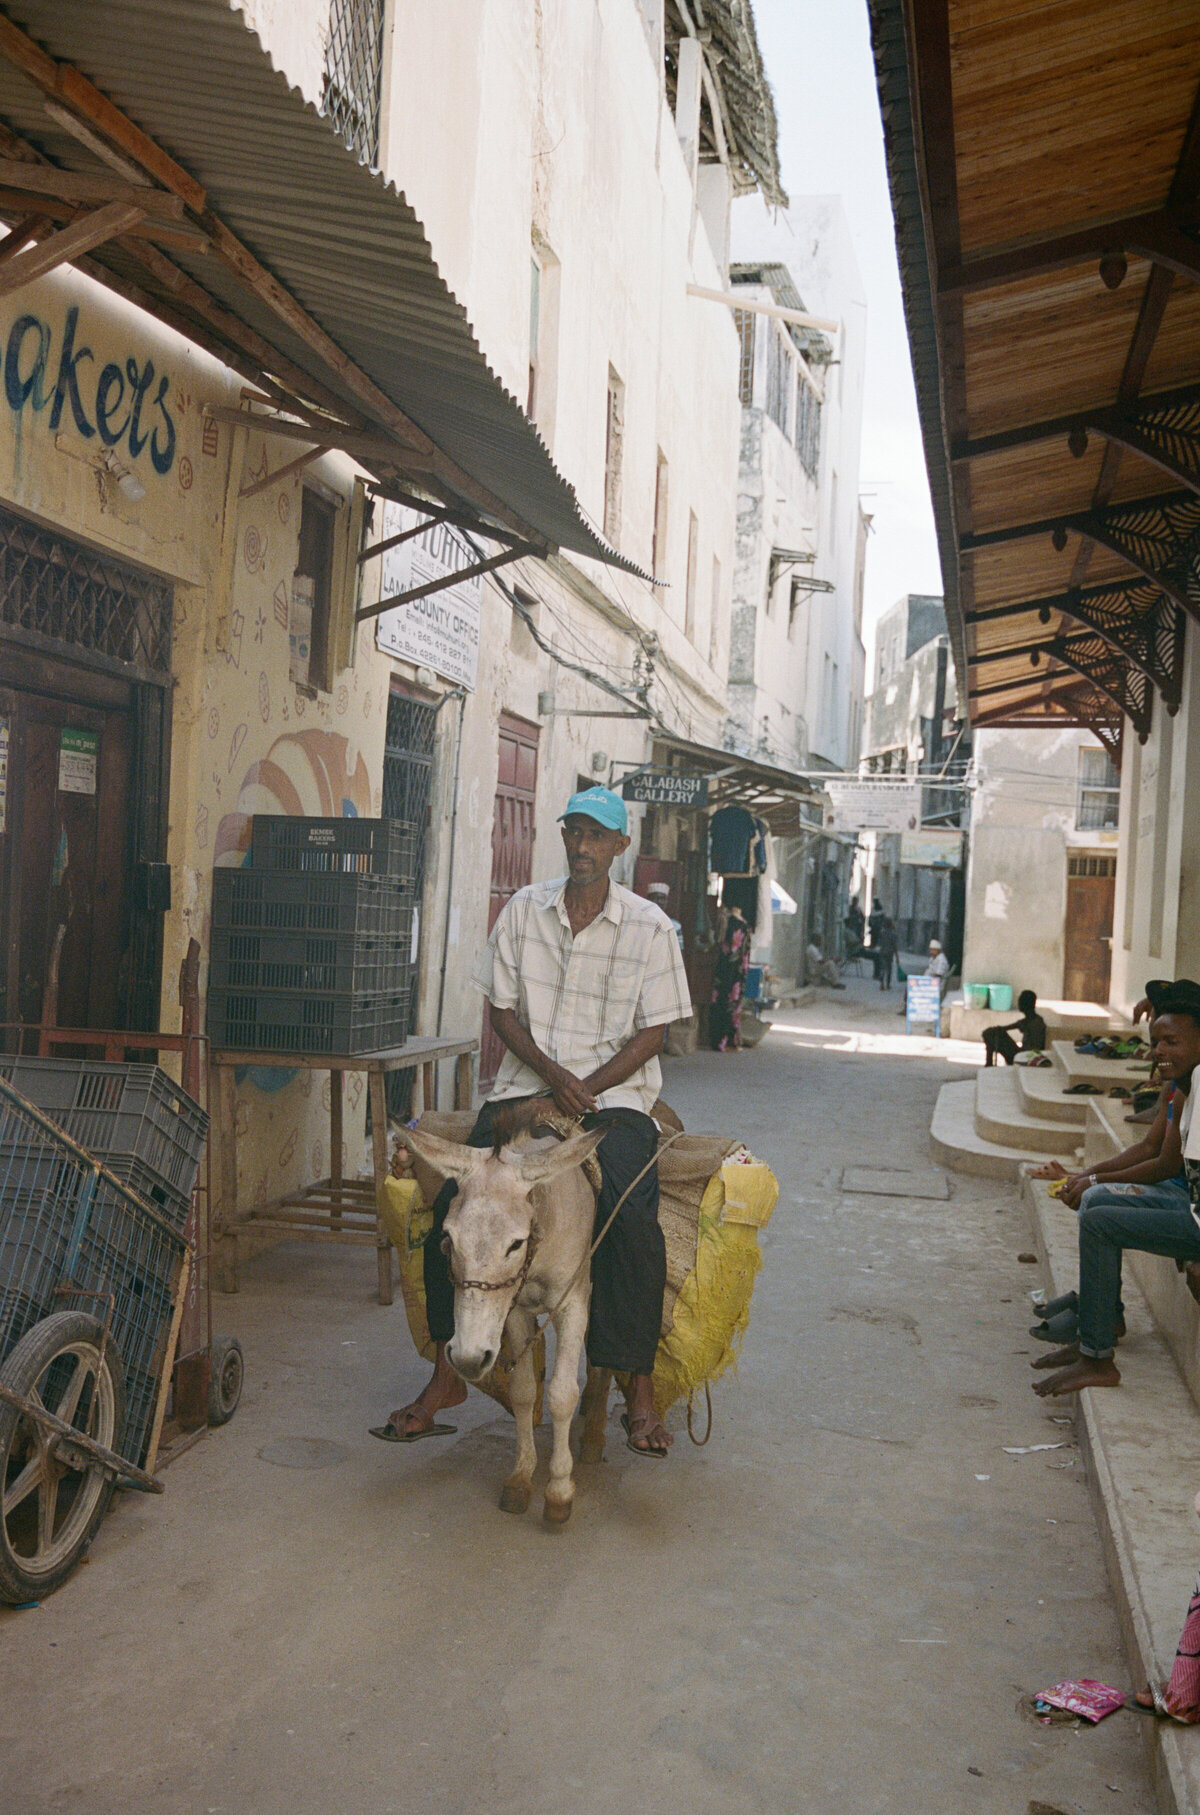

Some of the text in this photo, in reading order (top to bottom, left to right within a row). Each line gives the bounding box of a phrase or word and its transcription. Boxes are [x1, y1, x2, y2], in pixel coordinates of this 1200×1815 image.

[0, 305, 176, 475] akers
[413, 597, 451, 628] COUNTY
[453, 615, 479, 646] OFFICE
[631, 776, 701, 792] CALABASH
[634, 788, 695, 804] GALLERY
